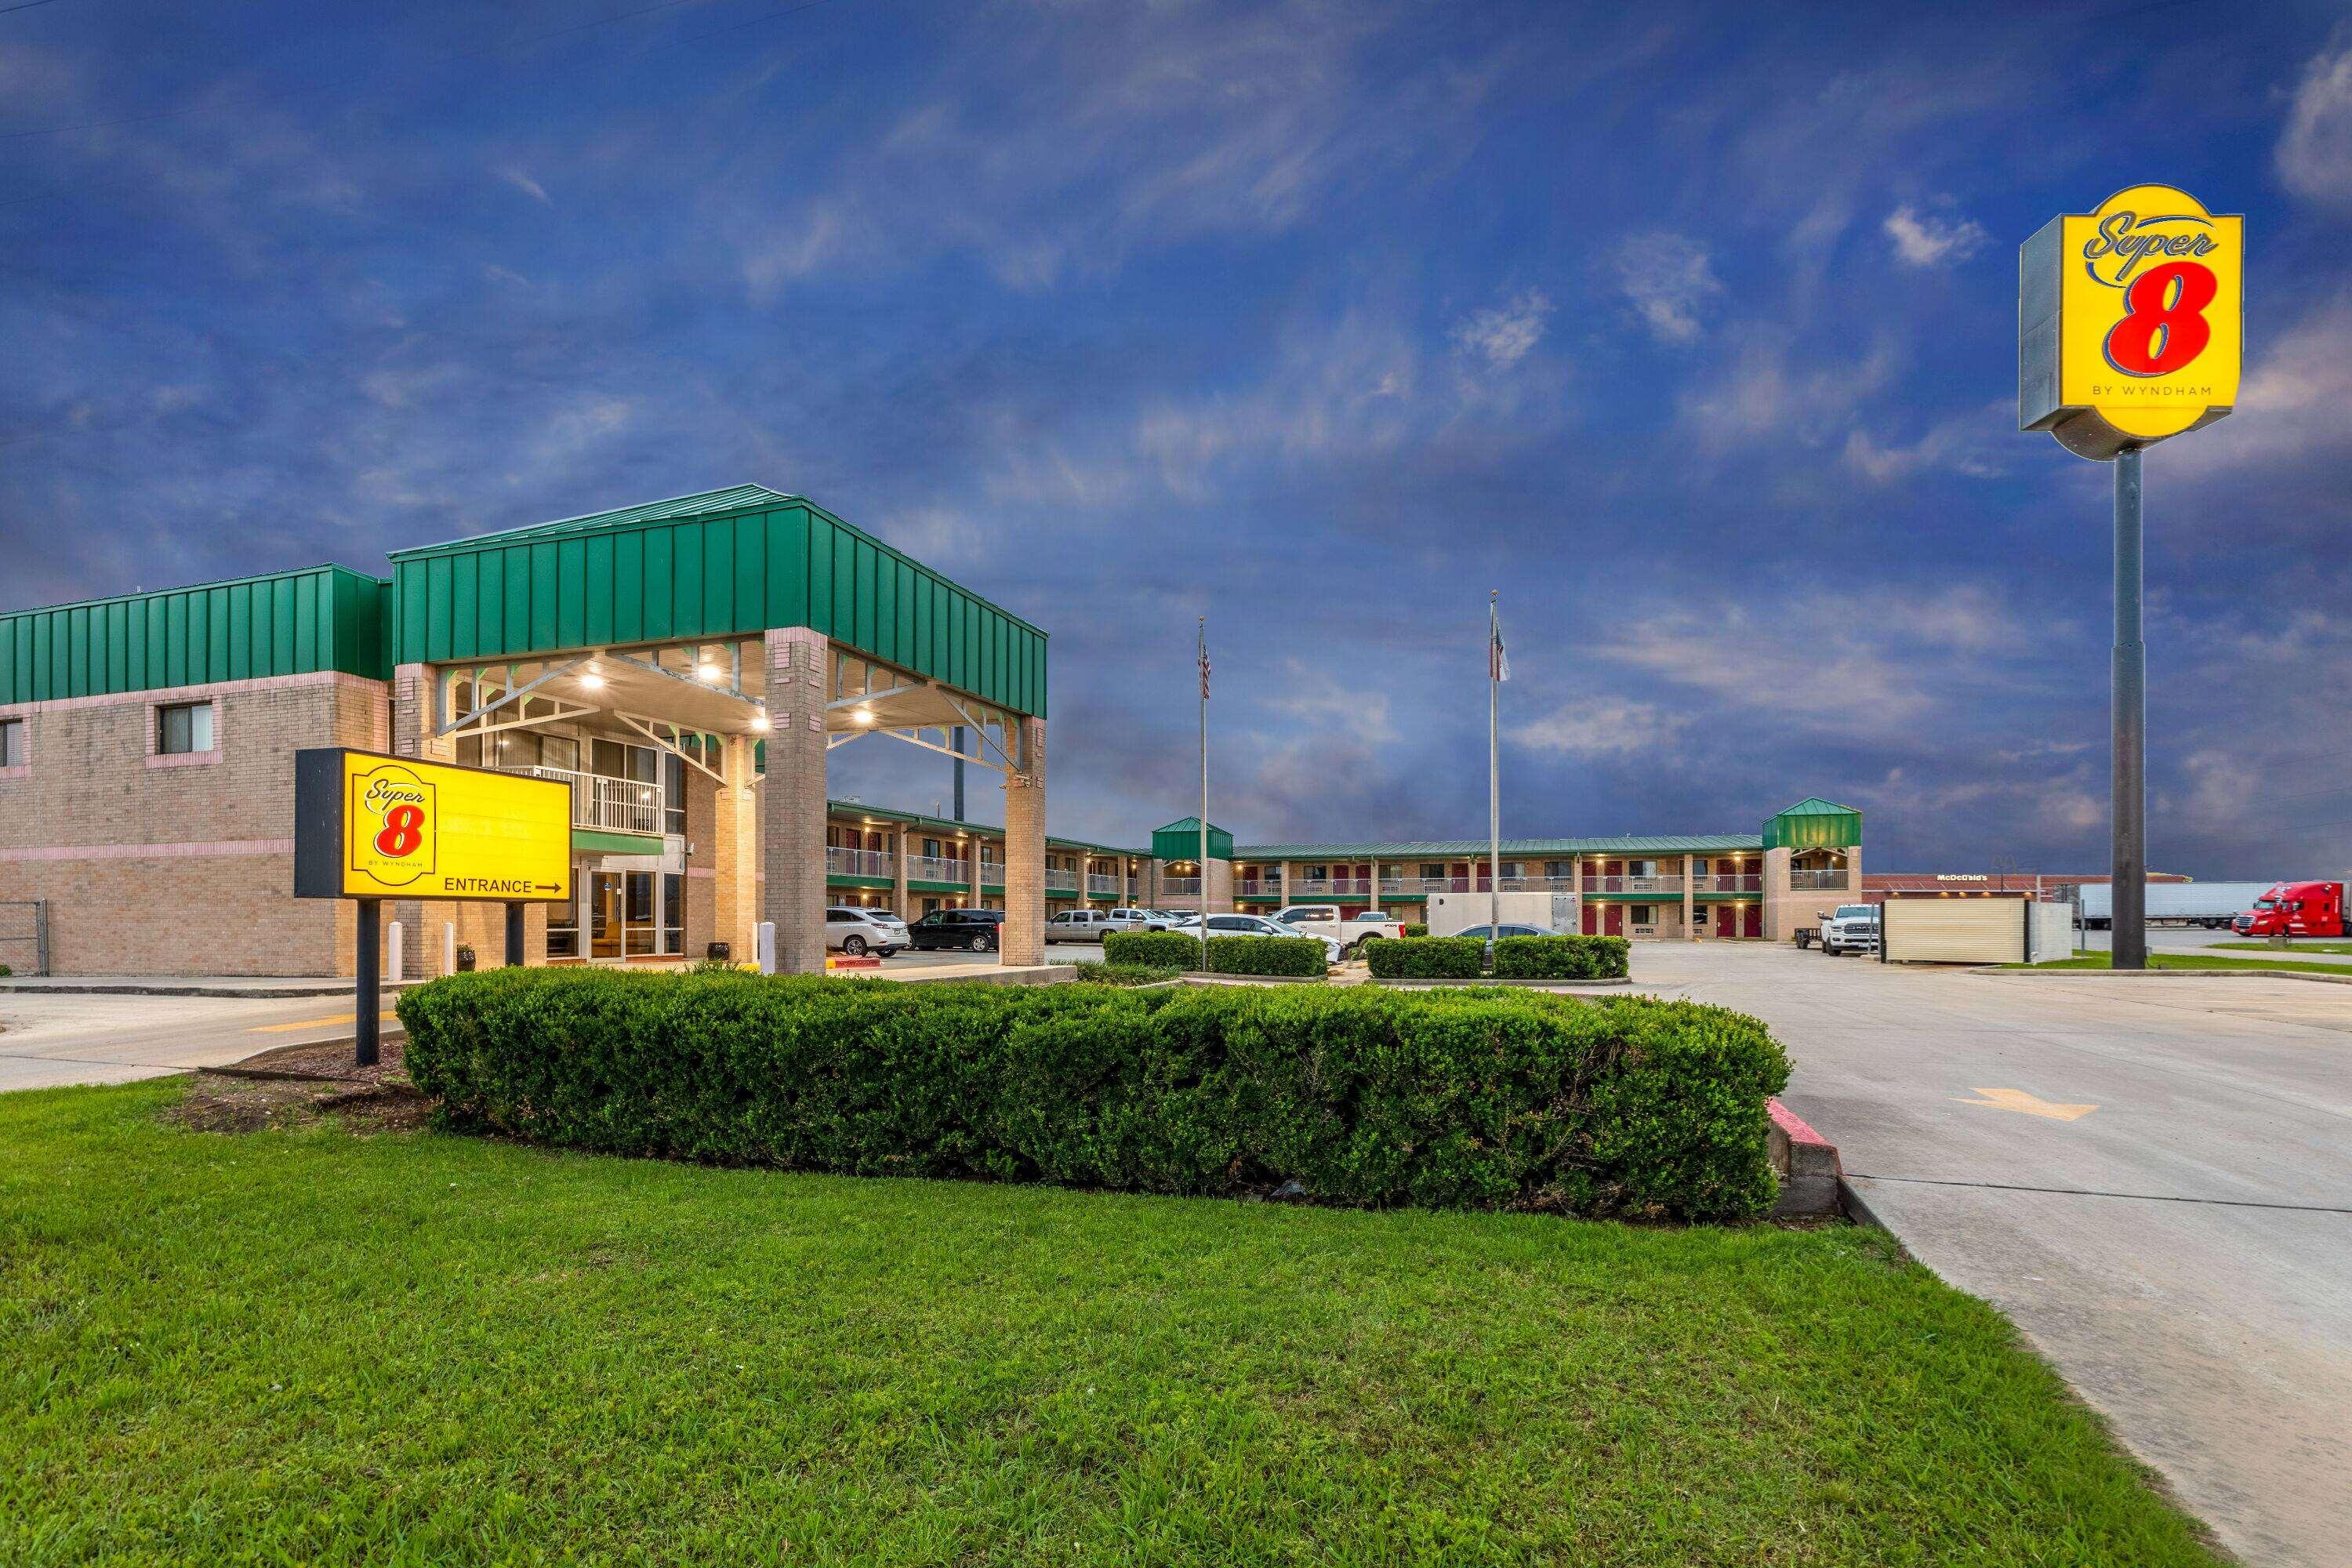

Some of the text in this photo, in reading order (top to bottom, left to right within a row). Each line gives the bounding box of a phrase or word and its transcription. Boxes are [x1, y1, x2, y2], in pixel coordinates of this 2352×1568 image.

[2082, 210, 2219, 282] Super
[2102, 260, 2218, 378] 8
[2092, 385, 2212, 397] BY WYNDHAM
[365, 778, 426, 811] Super
[373, 804, 426, 858] 8
[444, 877, 532, 893] ENTRANCE
